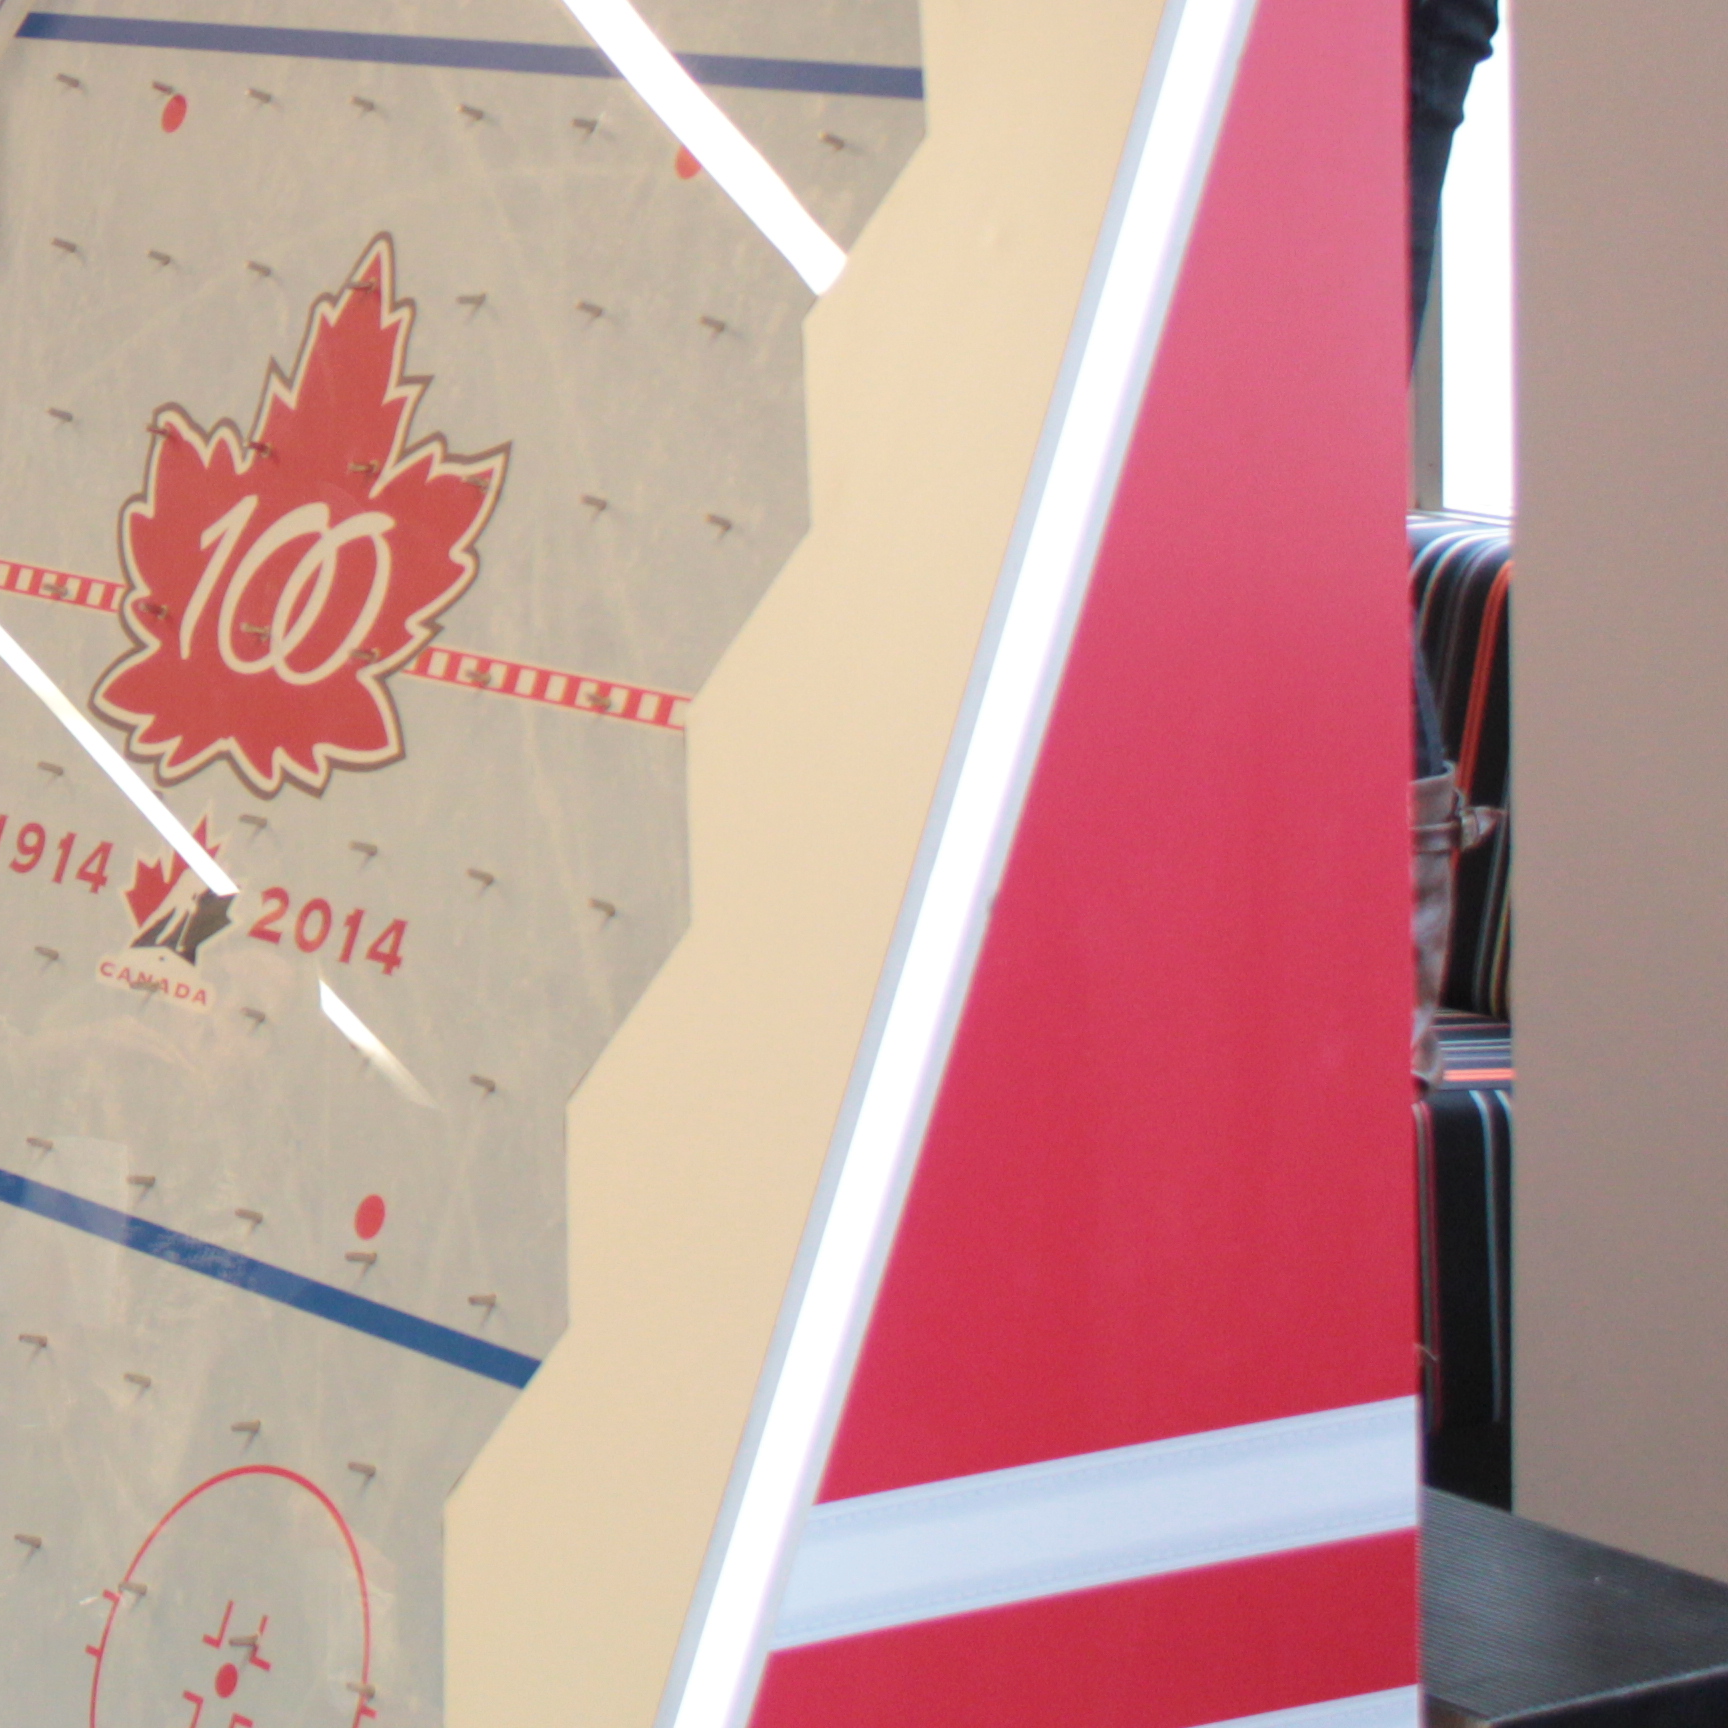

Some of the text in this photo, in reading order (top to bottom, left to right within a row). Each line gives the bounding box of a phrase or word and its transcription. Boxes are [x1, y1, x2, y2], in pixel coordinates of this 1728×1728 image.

[179, 493, 396, 687] 100
[247, 886, 409, 977] 2014
[98, 961, 209, 1007] CANADA
